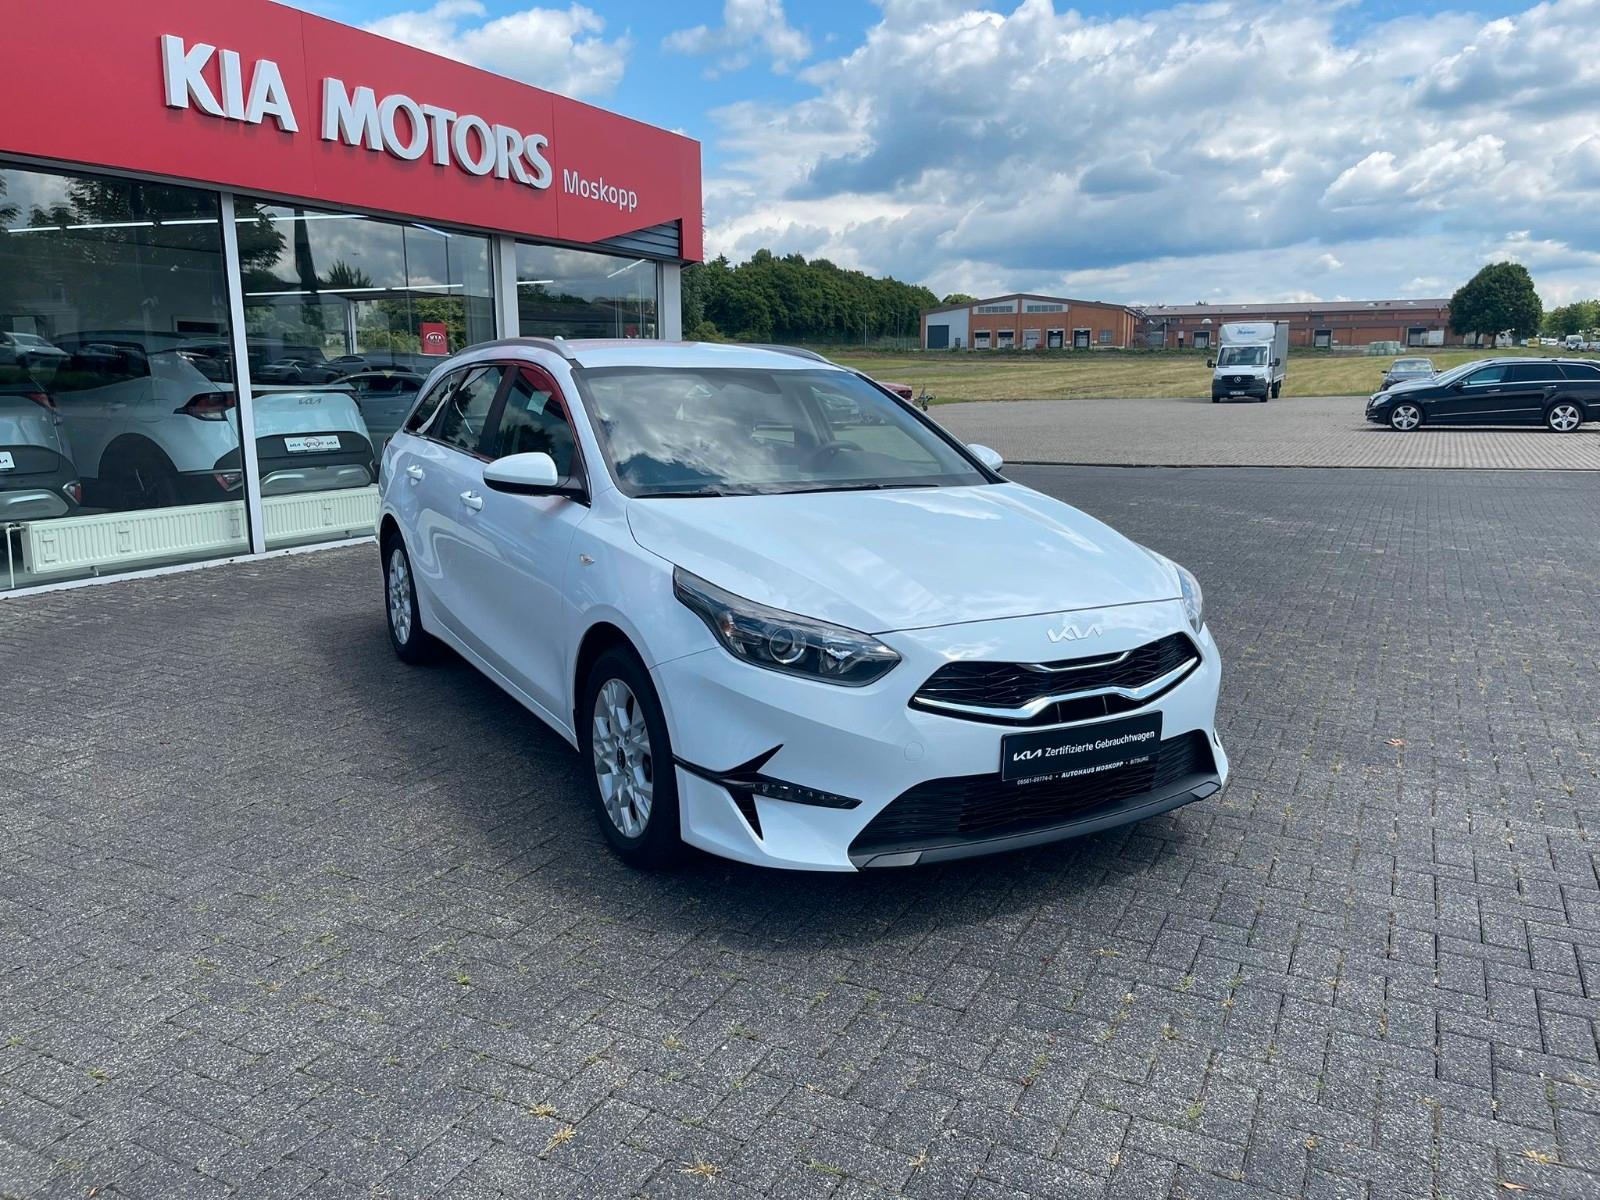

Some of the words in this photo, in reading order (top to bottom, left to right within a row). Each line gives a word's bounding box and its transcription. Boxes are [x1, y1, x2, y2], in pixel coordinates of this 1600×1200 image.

[161, 34, 299, 133] KIA
[321, 77, 553, 190] MOTORS
[563, 168, 639, 212] Moskopp
[1047, 624, 1103, 643] KIA
[1013, 748, 1043, 761] KIA
[1045, 743, 1094, 757] Zertifizierte
[1095, 730, 1155, 750] Gebrauchtwagen
[1061, 767, 1095, 778] AUTOHAUS
[1096, 761, 1124, 772] MOSKOPP
